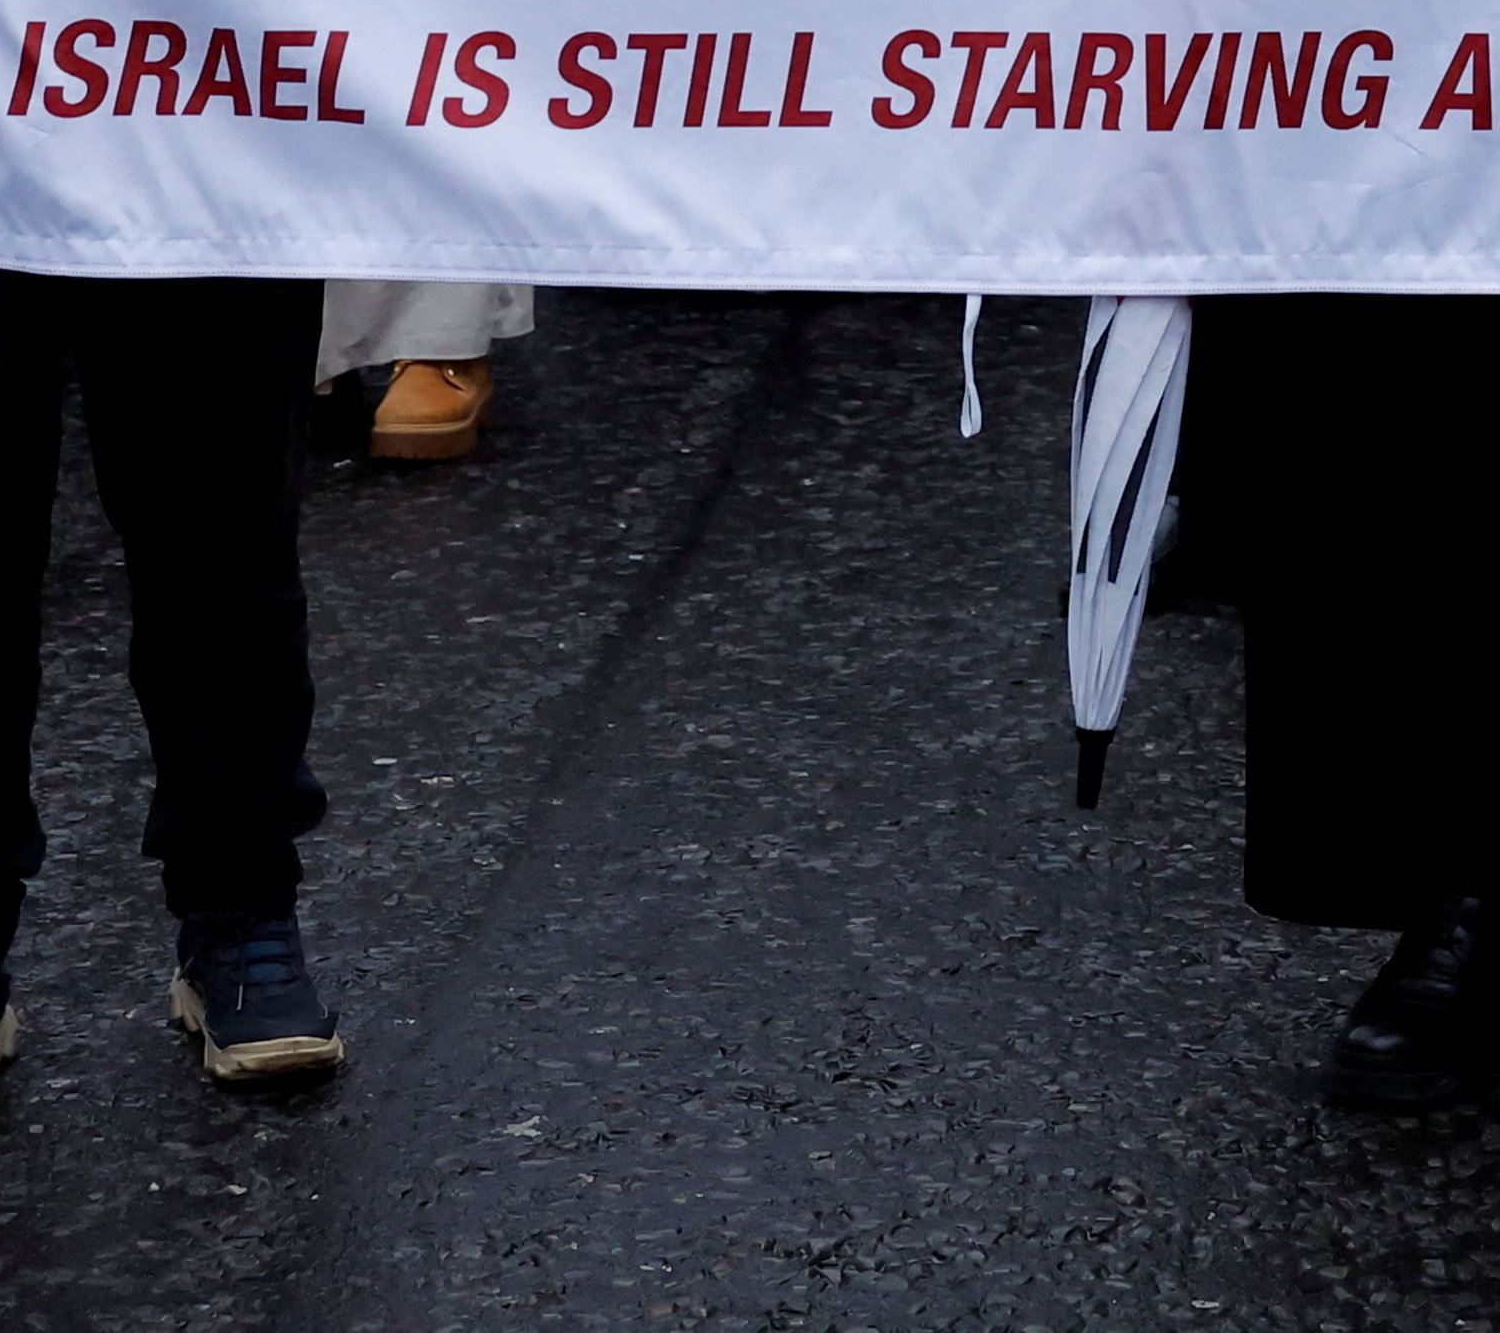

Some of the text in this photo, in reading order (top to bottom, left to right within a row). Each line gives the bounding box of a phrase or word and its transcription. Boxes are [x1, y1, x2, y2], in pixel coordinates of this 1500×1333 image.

[6, 18, 366, 125] ISRAEL
[405, 31, 517, 129] IS
[547, 31, 834, 131] STILL
[870, 29, 1394, 132] STARVING
